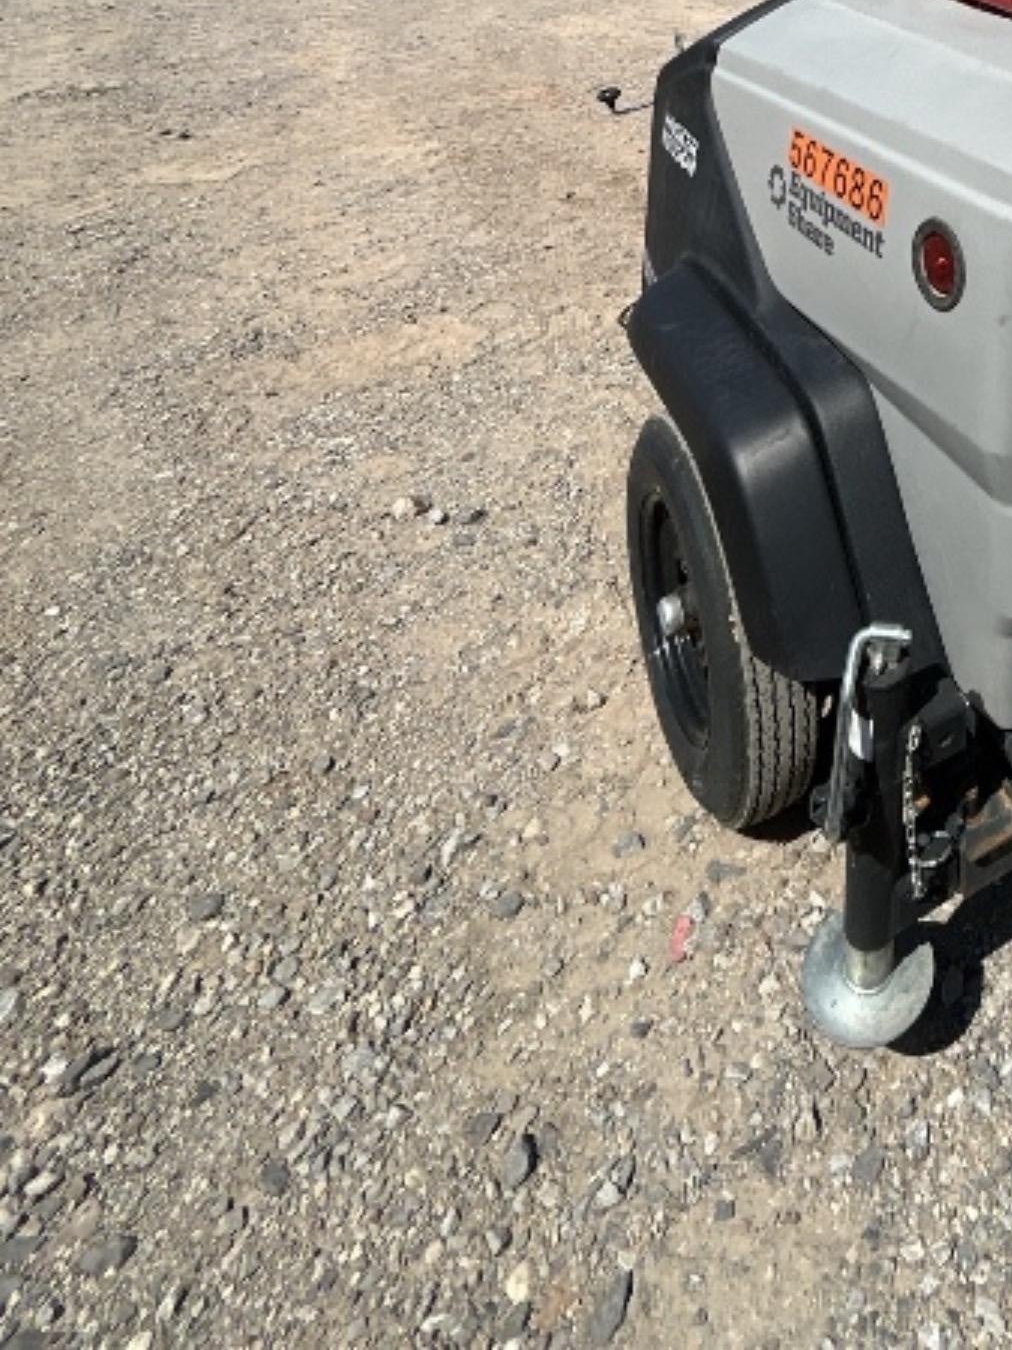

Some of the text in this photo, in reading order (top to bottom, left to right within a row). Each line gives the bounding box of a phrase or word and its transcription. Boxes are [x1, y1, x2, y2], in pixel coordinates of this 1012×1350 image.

[789, 131, 883, 221] 567686
[789, 171, 885, 258] Equipment
[788, 200, 834, 256] Share
